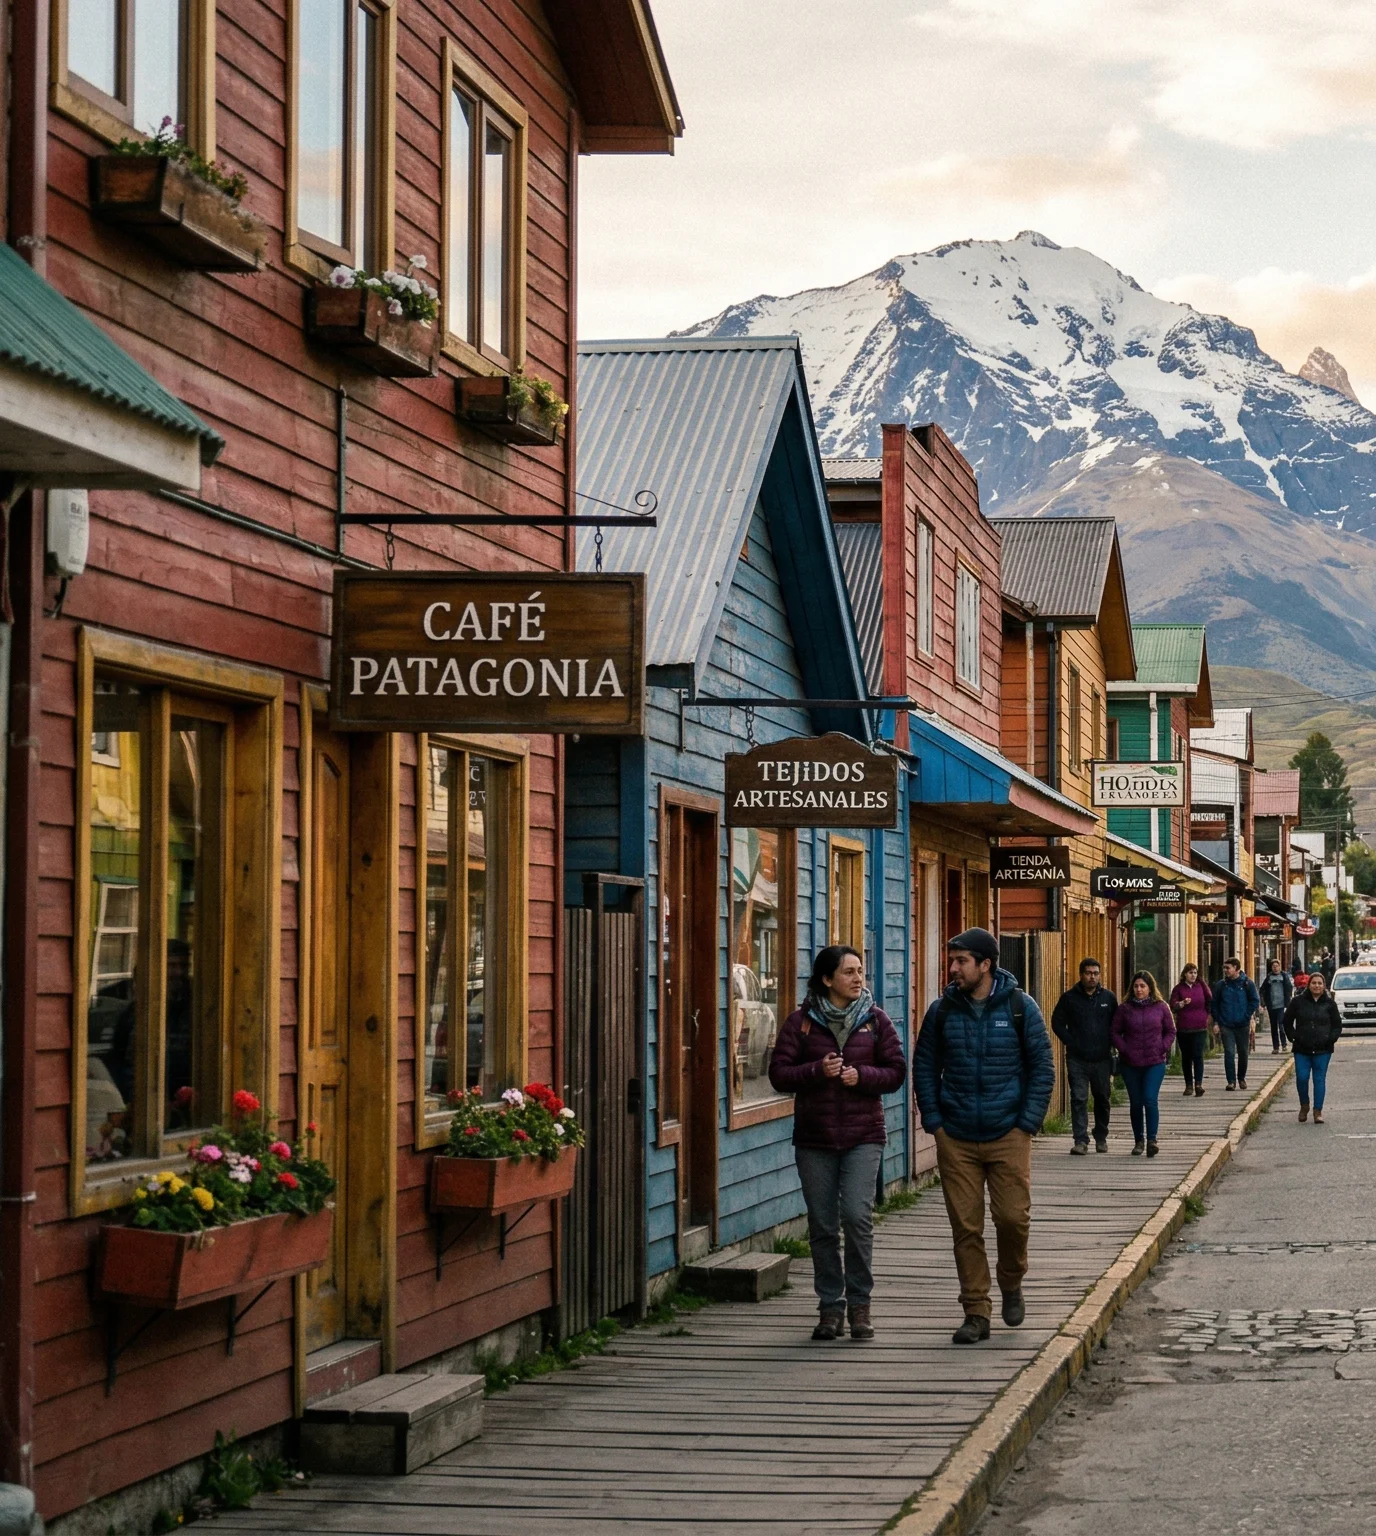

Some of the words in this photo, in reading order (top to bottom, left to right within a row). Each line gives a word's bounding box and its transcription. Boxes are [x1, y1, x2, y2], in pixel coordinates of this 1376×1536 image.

[423, 591, 547, 642] CAFÉ
[350, 656, 625, 698] PATAGONIA
[733, 790, 888, 809] ARTESANALES
[1009, 855, 1052, 866] TIENDA
[995, 866, 1066, 880] ARTESANÍA
